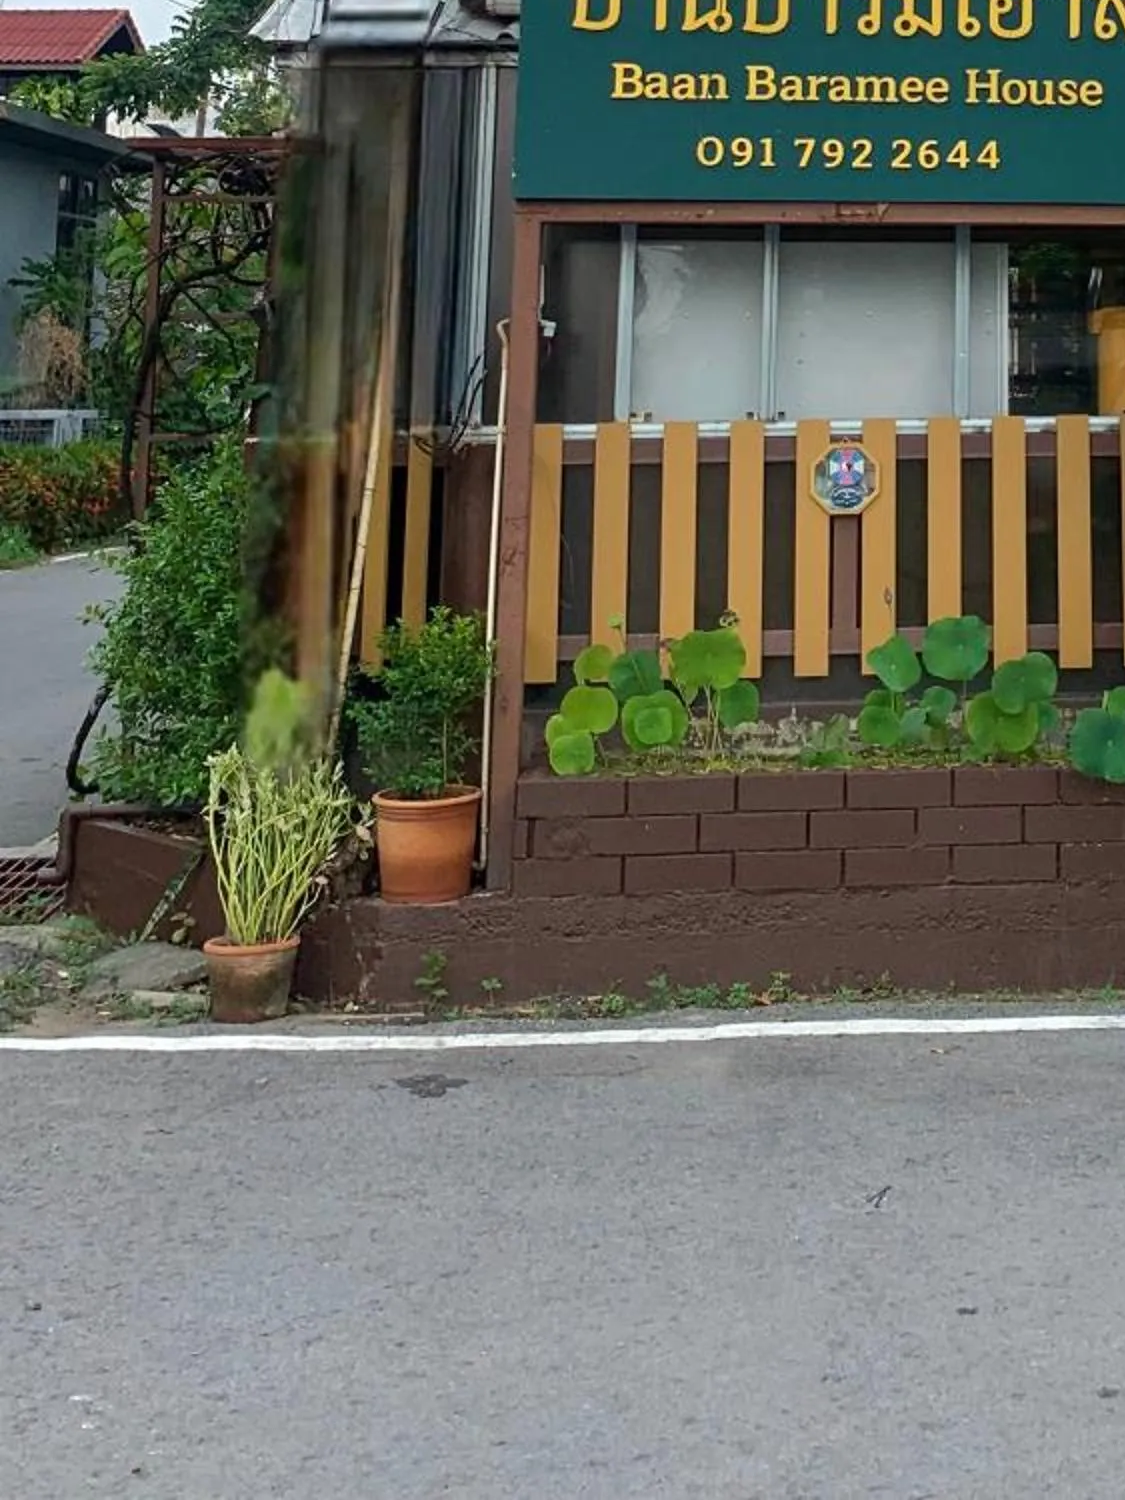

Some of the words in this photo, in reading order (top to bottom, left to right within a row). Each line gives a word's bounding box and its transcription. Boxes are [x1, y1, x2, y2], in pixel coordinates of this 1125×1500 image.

[611, 63, 729, 101] Baan
[744, 64, 950, 105] Baramee
[965, 69, 1104, 107] House
[695, 135, 776, 168] 091
[794, 138, 874, 169] 792
[890, 139, 1001, 170] 2644
